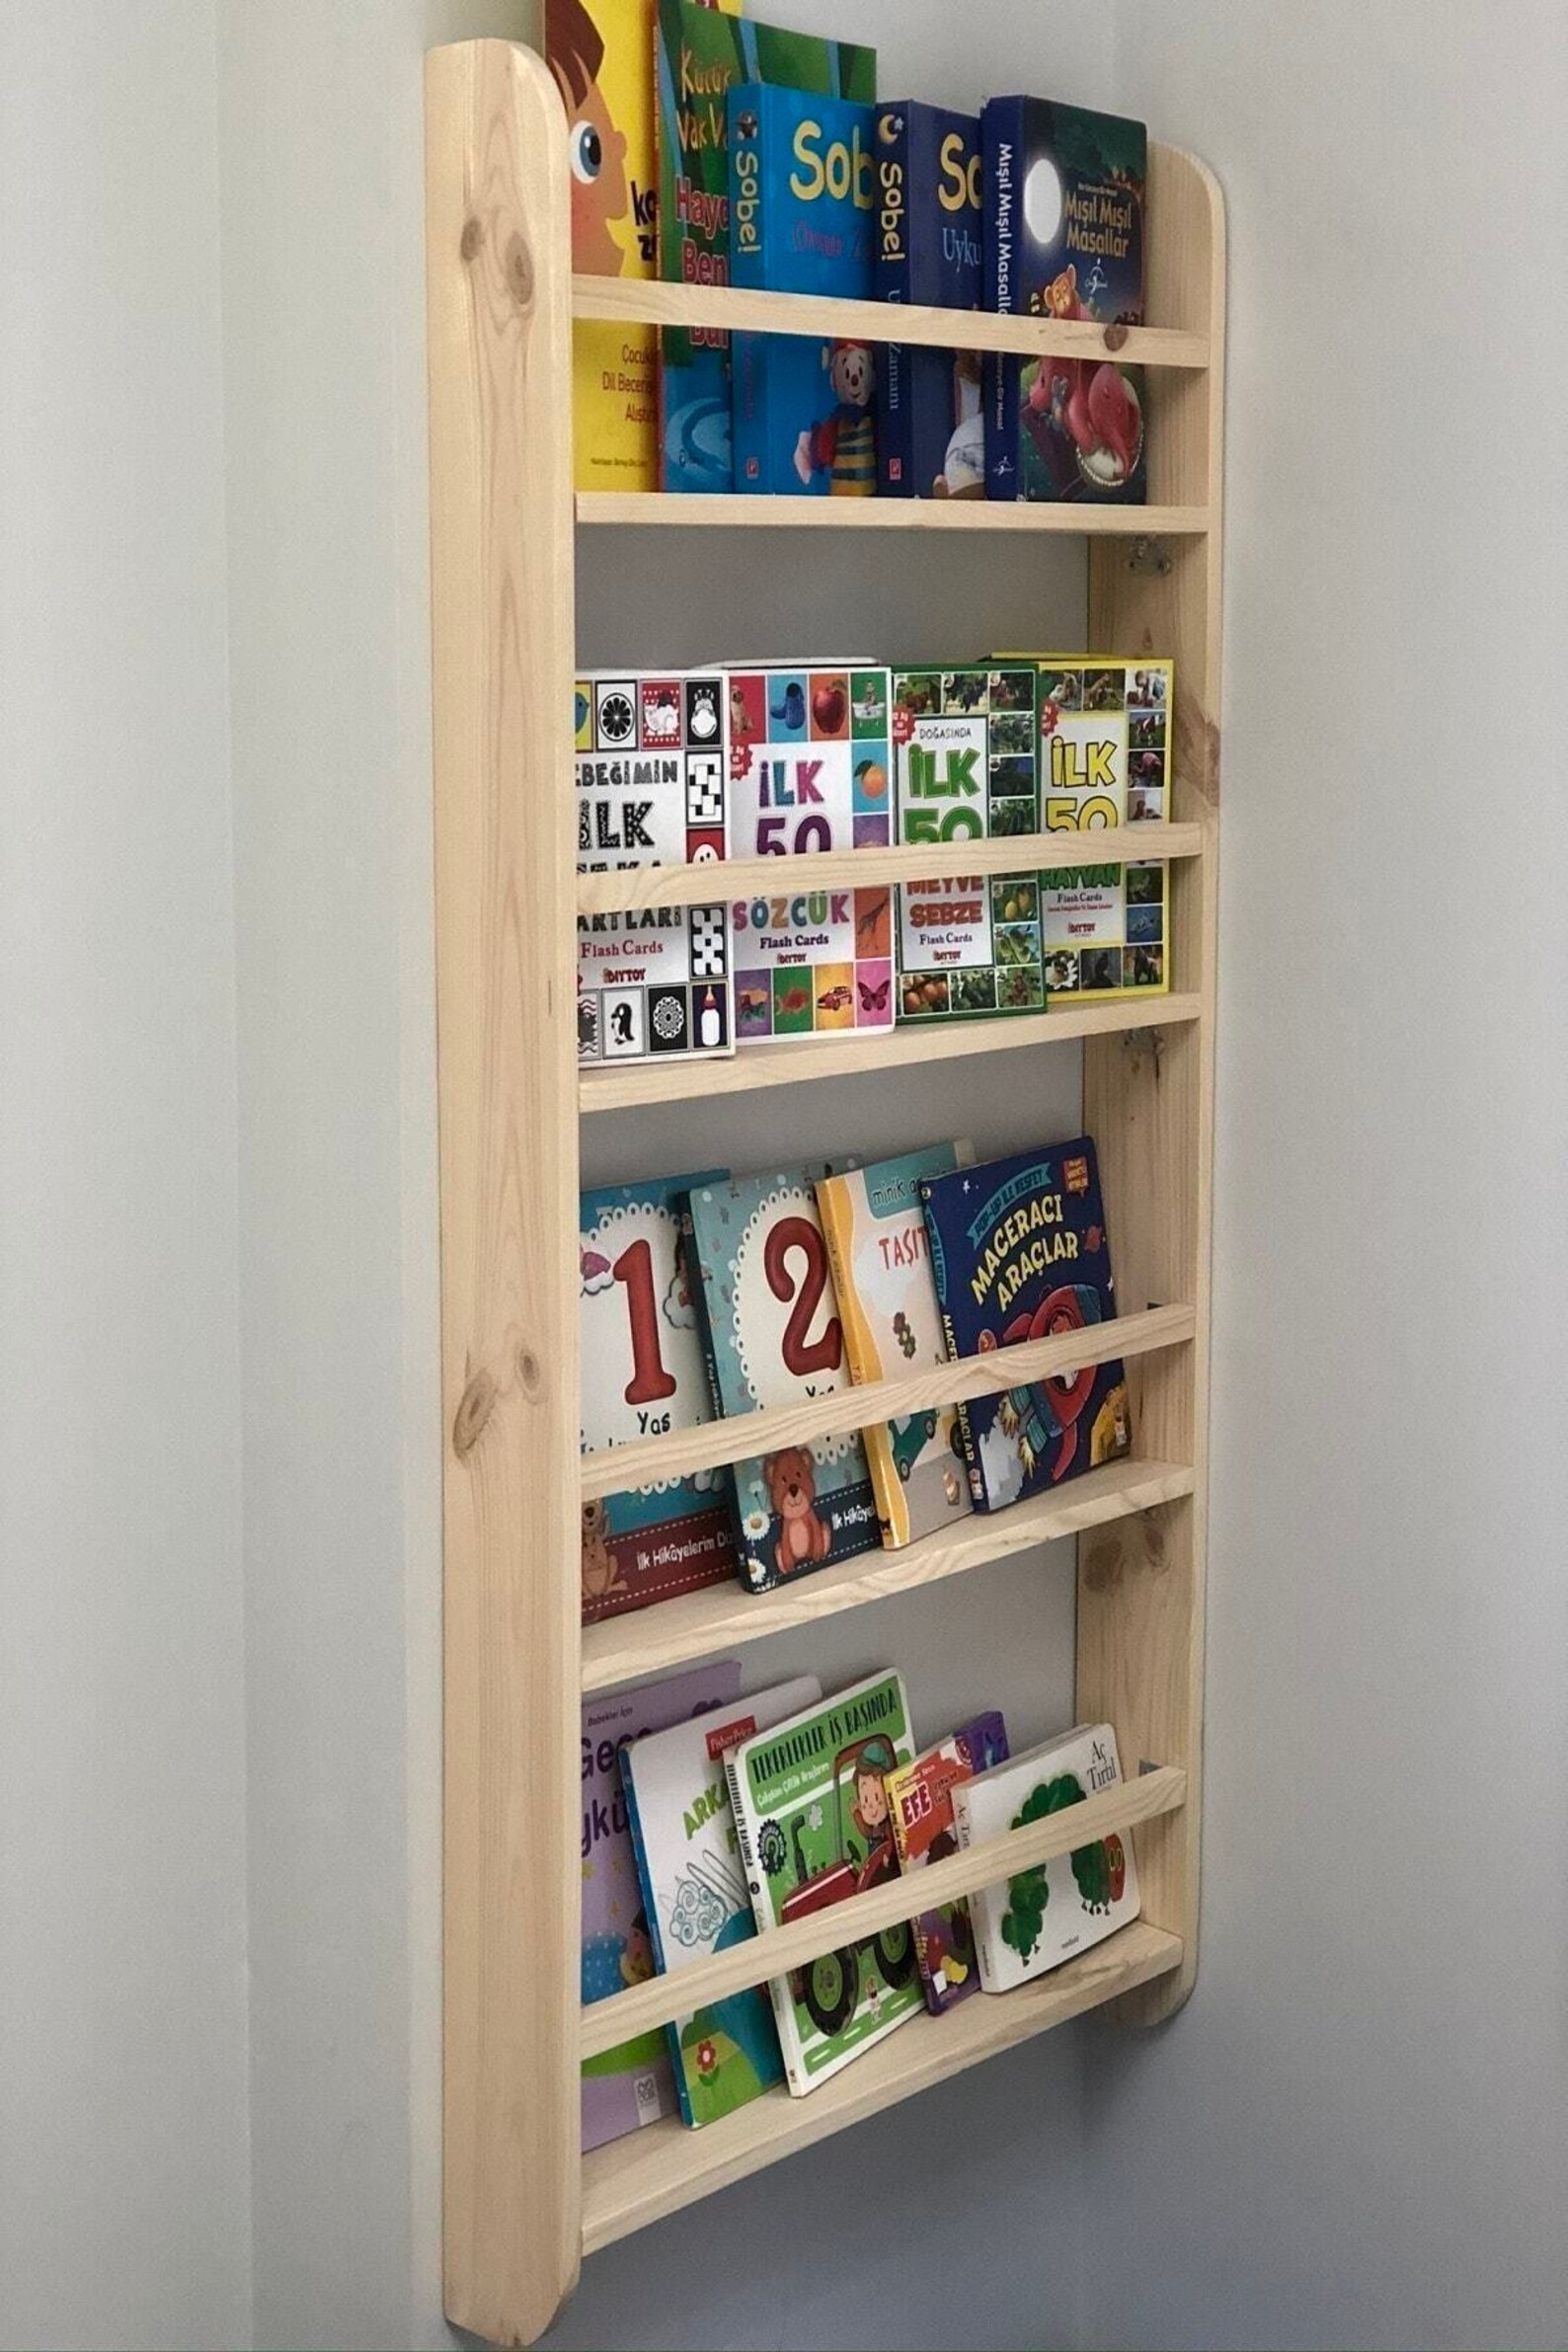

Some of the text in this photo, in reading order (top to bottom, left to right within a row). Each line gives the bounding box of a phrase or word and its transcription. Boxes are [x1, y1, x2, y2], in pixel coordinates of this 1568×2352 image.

[996, 143, 1012, 189] Mışıl
[736, 150, 761, 253] Sobe!
[880, 161, 905, 261] Sobe!
[995, 194, 1012, 239] Mışıl
[1064, 190, 1131, 235] Mışıl Mışıl
[1066, 221, 1129, 258] Masallar
[919, 728, 972, 740] DOĞASINDA
[904, 806, 983, 844] 50
[1046, 796, 1118, 830] 50
[756, 815, 831, 856] 50
[733, 890, 849, 931] SÖZCÜK
[909, 901, 982, 927] SEBZE
[1058, 893, 1103, 902] Flash Cards
[581, 940, 664, 958] Flash Cards
[759, 934, 829, 949] Flash Cards
[919, 932, 973, 945] Flash Cards
[971, 1194, 1063, 1305] MACERACI
[997, 1231, 1078, 1313] ARAÇLAR
[764, 1215, 843, 1377] 2
[613, 1239, 676, 1406] 1
[653, 1535, 715, 1567] Hikâyelerim
[844, 1688, 897, 1736] BAŞINDA
[901, 1781, 932, 1829] EFE
